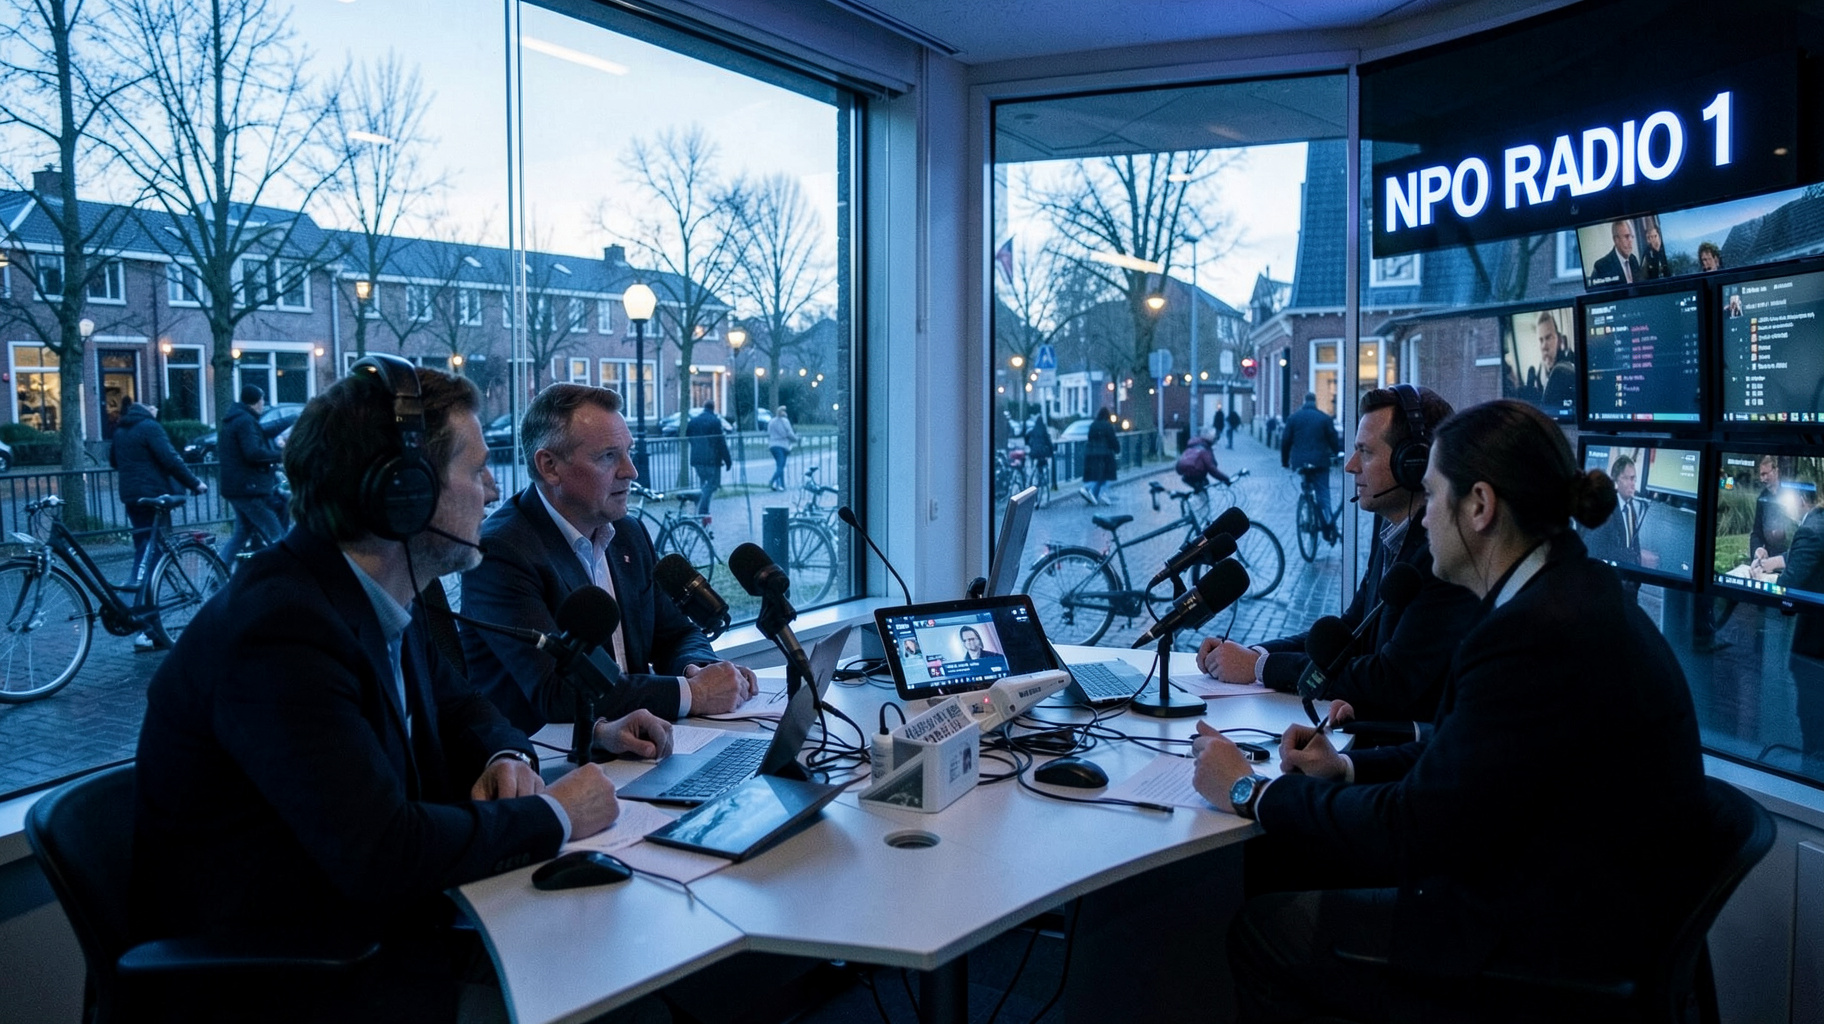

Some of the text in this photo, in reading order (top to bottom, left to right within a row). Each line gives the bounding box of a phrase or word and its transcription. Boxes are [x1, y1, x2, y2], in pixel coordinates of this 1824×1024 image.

[1386, 91, 1733, 233] NPO RADIO 1
